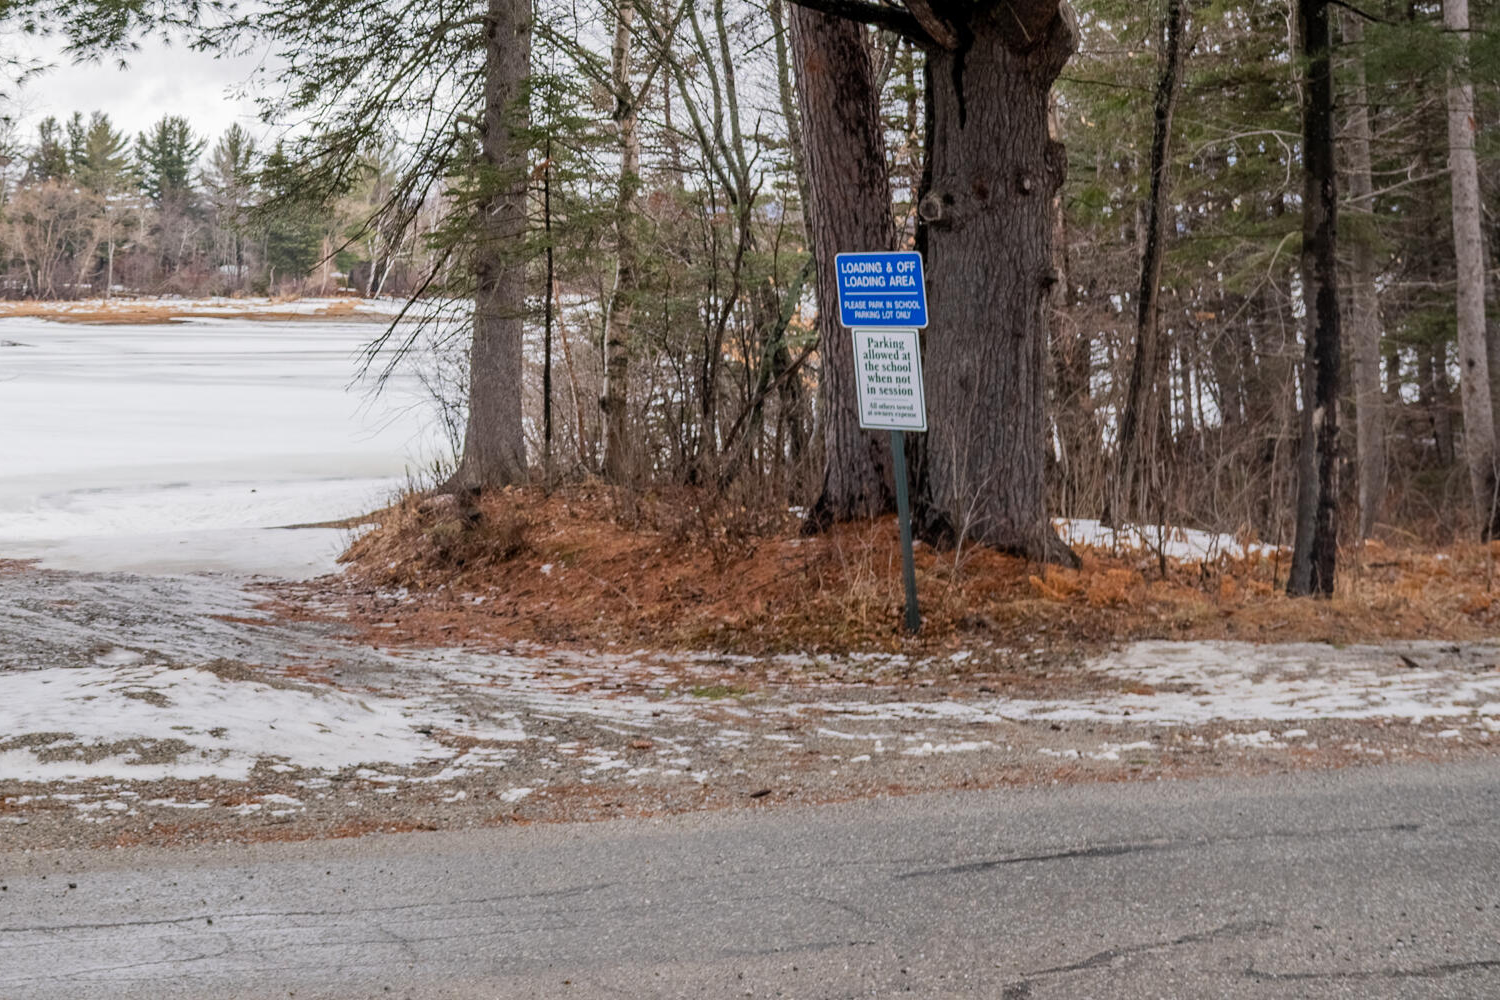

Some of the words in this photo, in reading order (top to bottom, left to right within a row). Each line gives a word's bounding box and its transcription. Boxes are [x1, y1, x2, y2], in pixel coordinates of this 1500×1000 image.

[841, 262, 882, 273] LOADING
[886, 262, 892, 272] &
[897, 262, 915, 273] OFF
[845, 276, 885, 287] LOADING
[890, 275, 915, 287] AREA
[844, 301, 866, 309] PLEASE
[895, 301, 920, 309] SCHOOL
[855, 311, 880, 319] PARKING
[882, 311, 893, 319] LOT
[896, 311, 911, 319] ONLY
[868, 338, 904, 350] Parking
[864, 350, 899, 361] allowed
[902, 351, 910, 361] at
[865, 362, 879, 372] the
[882, 362, 911, 373] school
[868, 374, 892, 383] when
[896, 375, 910, 384] not
[867, 385, 876, 394] in
[879, 386, 913, 396] session
